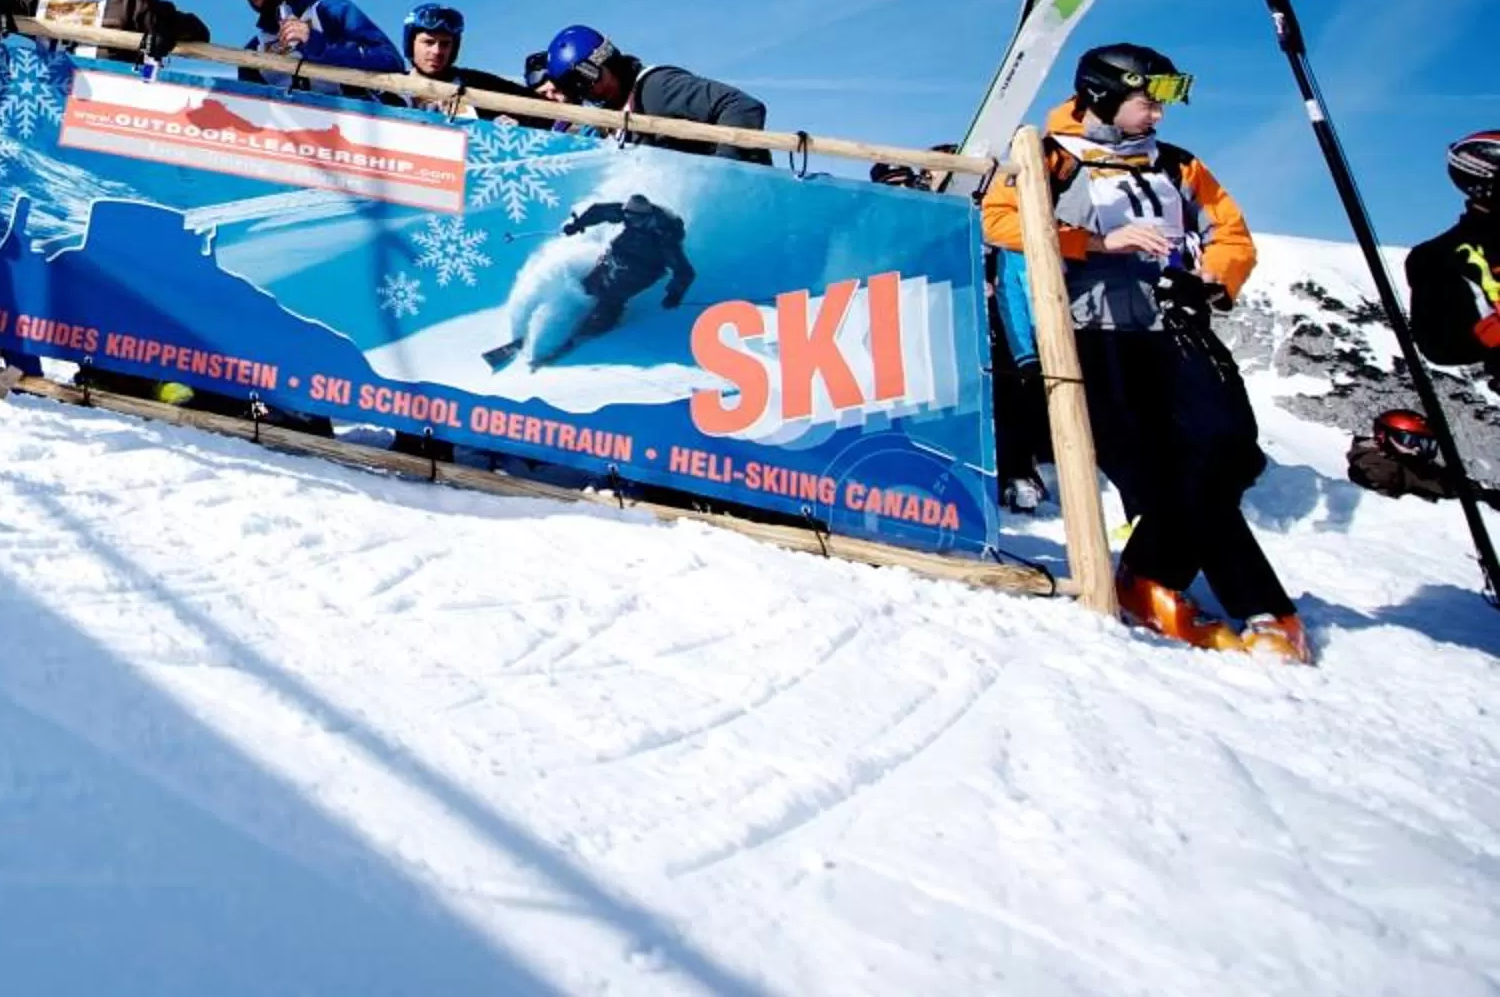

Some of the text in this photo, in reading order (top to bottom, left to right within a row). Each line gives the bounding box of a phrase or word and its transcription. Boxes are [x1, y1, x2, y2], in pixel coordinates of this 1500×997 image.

[15, 313, 100, 352] GUIDES
[106, 332, 279, 390] KRIPPENSTEIN
[309, 373, 352, 405] SKI
[358, 385, 462, 428] SCHOOL
[470, 405, 634, 462] OBERTRAUN
[669, 445, 836, 506] HELI-SKIING
[845, 480, 961, 531] CANADA
[690, 271, 906, 437] SKI
